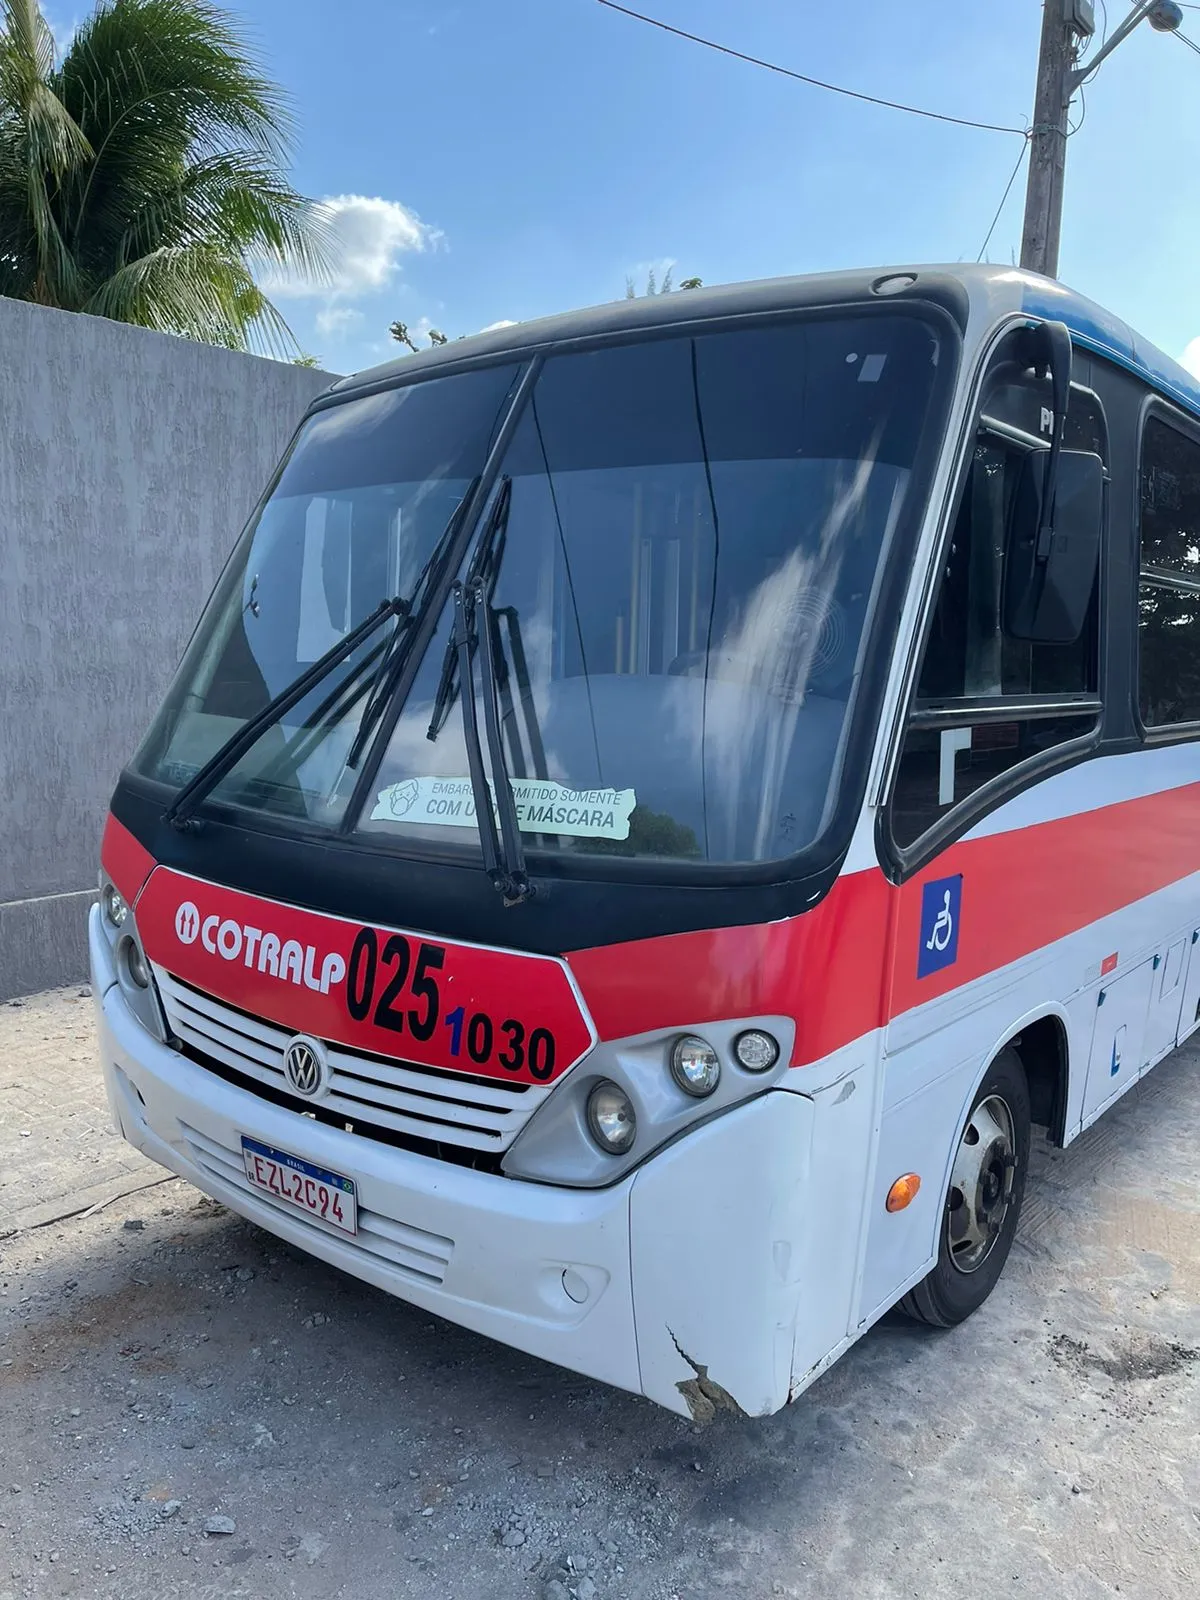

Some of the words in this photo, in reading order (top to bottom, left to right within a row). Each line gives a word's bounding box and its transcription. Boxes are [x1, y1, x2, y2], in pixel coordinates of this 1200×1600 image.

[426, 799, 462, 816] COM
[527, 803, 614, 828] MÁSCARA
[432, 783, 490, 797] EMBAR
[560, 790, 622, 805] SOMENTE
[201, 915, 346, 994] COTRALP
[346, 927, 446, 1042] 025
[445, 1006, 555, 1080] 1030
[253, 1155, 343, 1223] EZL2C94
[286, 1159, 306, 1172] BRASIL
